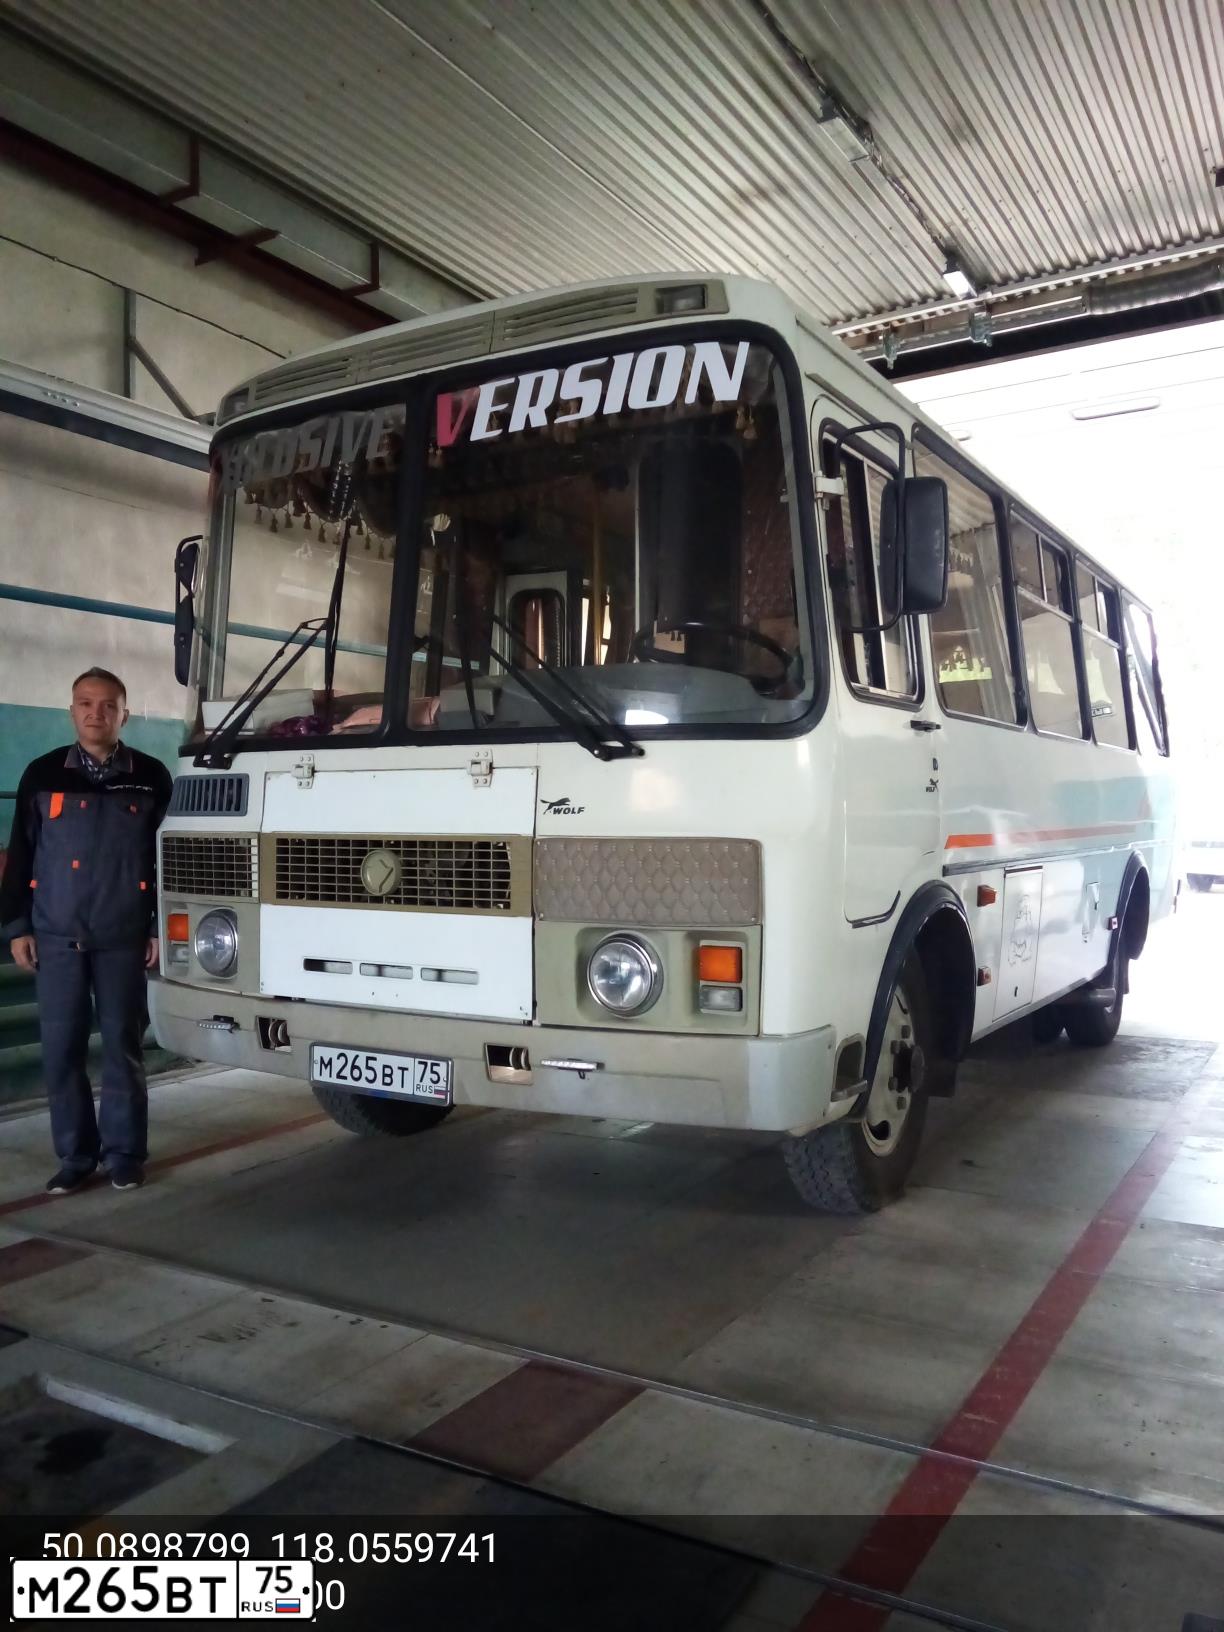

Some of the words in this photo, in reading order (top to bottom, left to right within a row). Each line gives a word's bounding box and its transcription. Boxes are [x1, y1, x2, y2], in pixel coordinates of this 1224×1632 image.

[436, 341, 750, 447] VERSION
[552, 806, 585, 815] WOLF
[417, 1060, 441, 1085] 75
[415, 1083, 433, 1094] RUS
